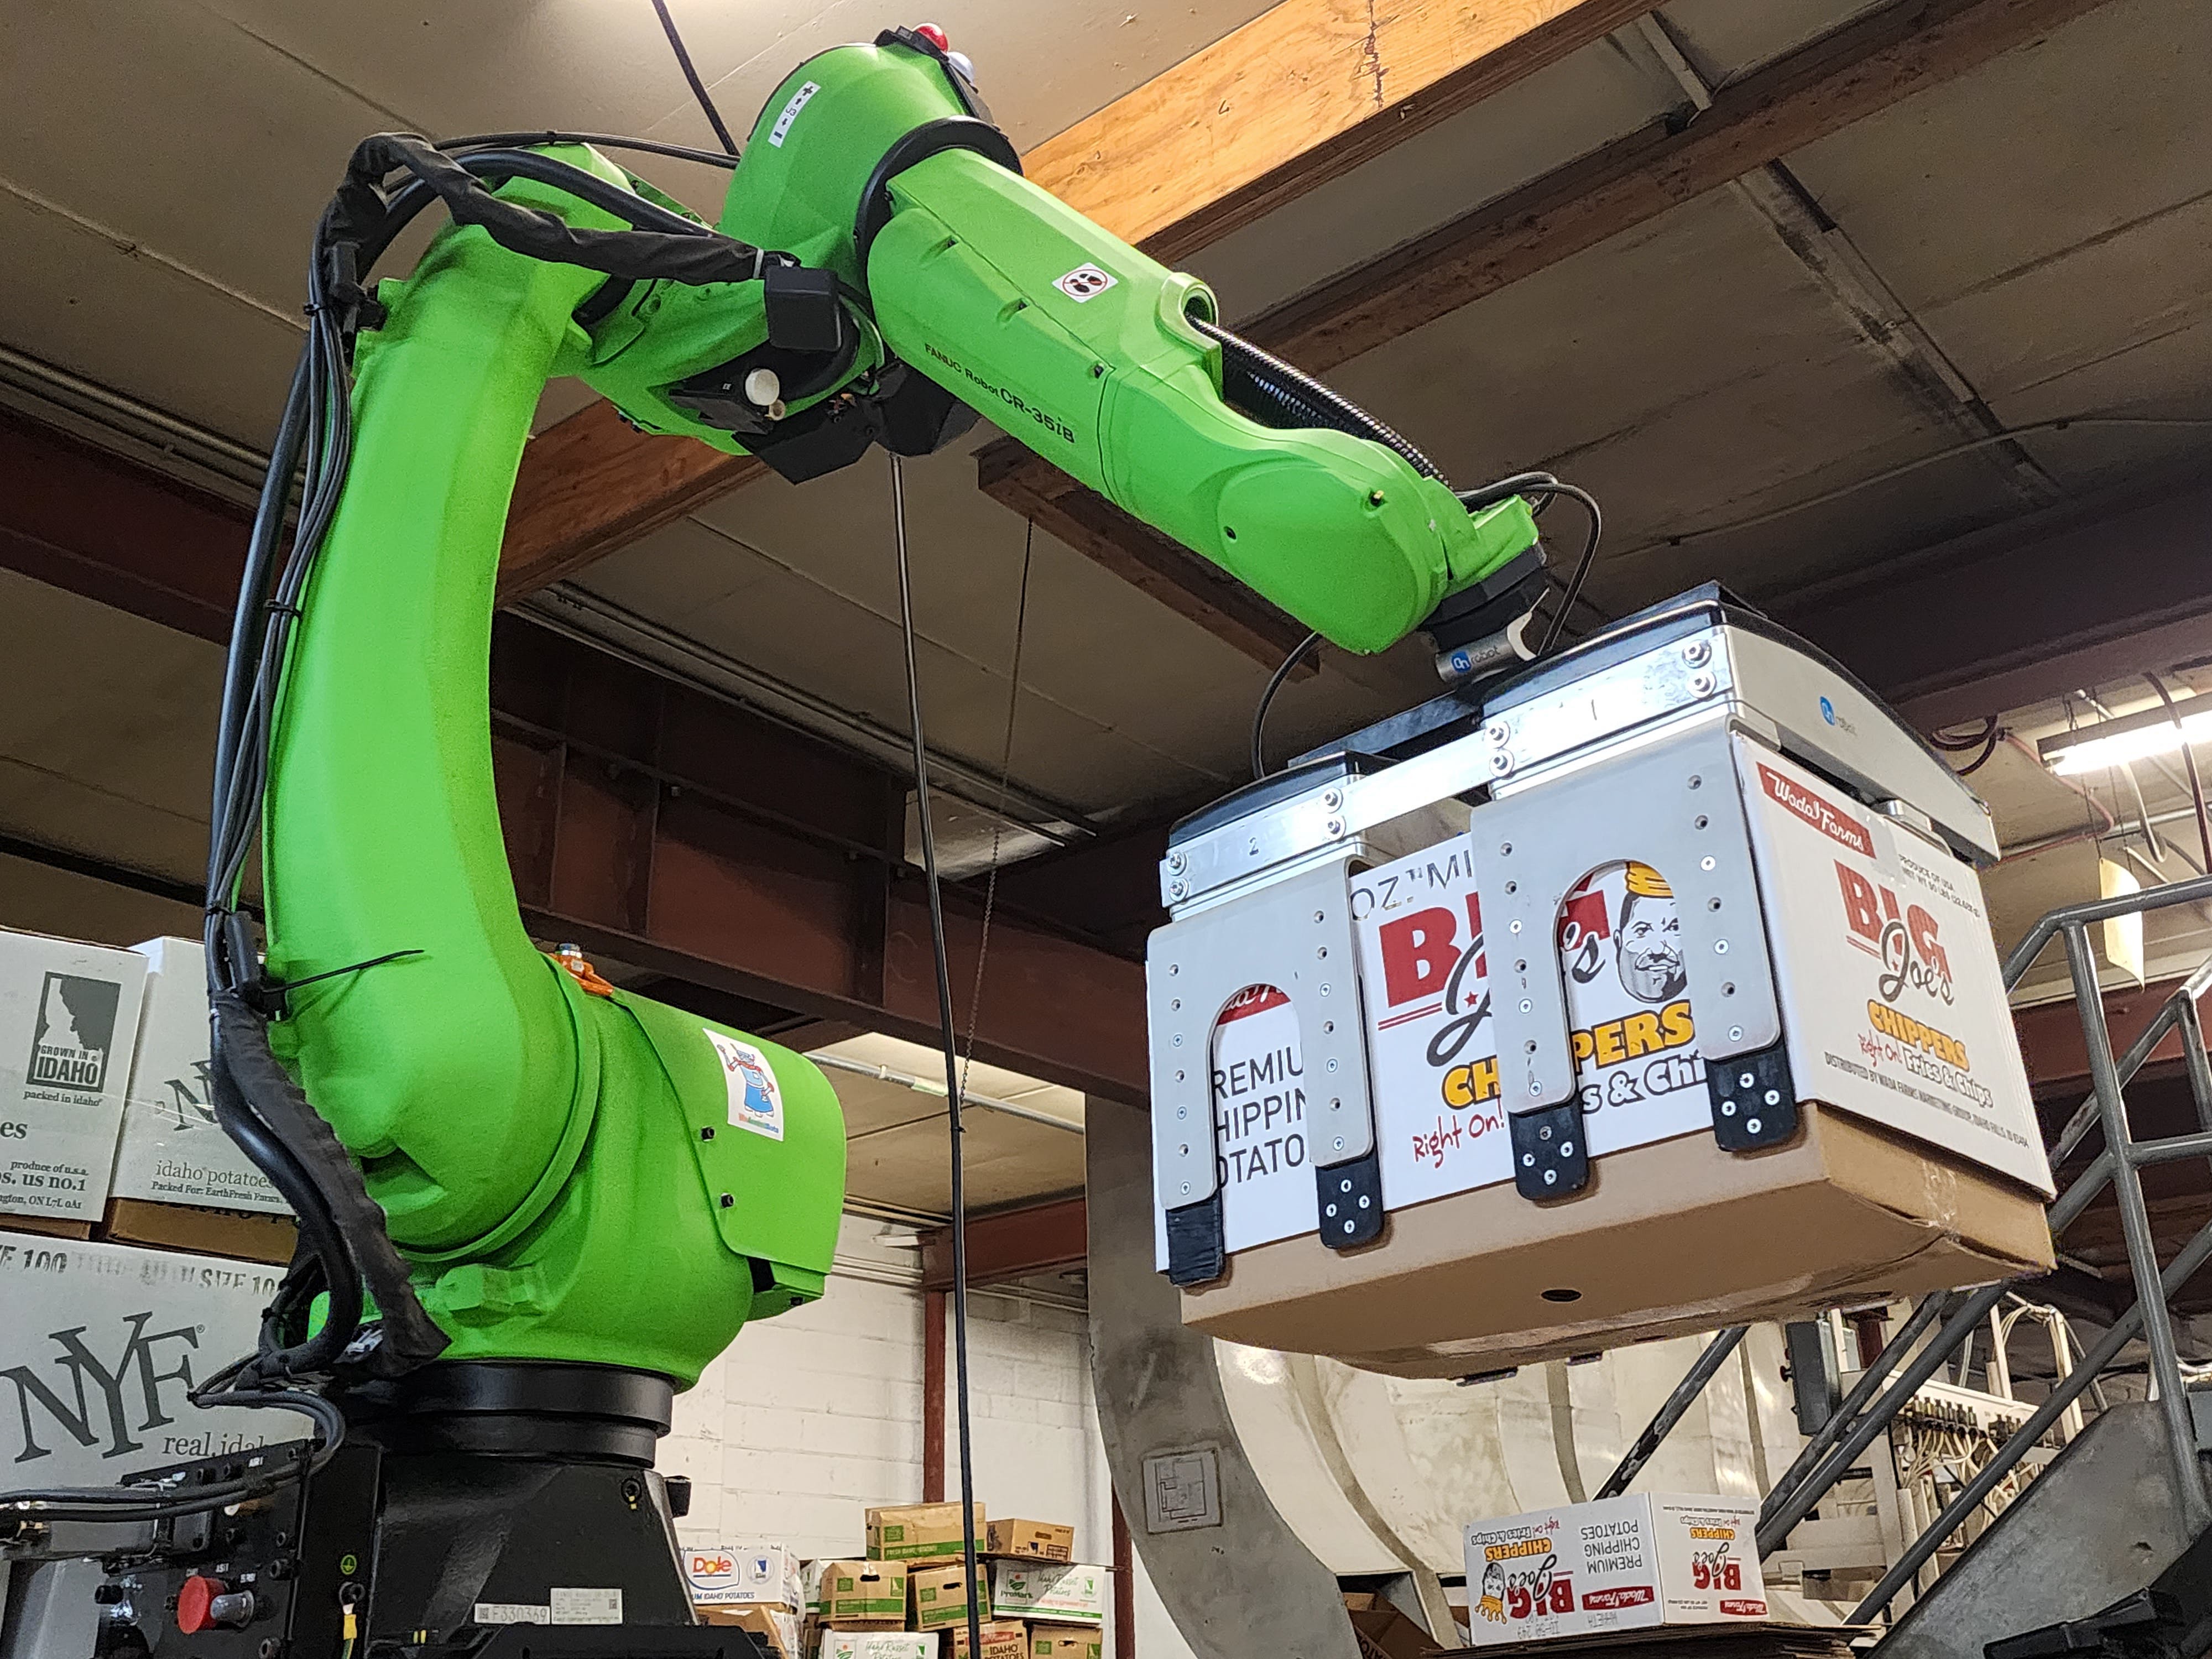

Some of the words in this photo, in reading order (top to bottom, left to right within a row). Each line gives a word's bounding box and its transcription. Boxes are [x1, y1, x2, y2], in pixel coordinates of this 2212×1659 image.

[925, 343, 962, 373] FANUC
[965, 368, 999, 398] Robot
[1000, 388, 1075, 443] CR-35iB
[1766, 772, 1815, 819] Wada
[1820, 808, 1865, 852] Farms
[1249, 837, 1259, 856] 2
[1426, 849, 1473, 889] MI
[1833, 859, 1953, 983] BIG
[1879, 921, 1954, 1006] Joe's
[1867, 999, 1970, 1072] CHIPPERS
[41, 1045, 76, 1058] GROWN
[79, 1051, 89, 1061] IN
[36, 1057, 98, 1085] IDAHO
[1212, 1046, 1303, 1099] REMIU
[1903, 1046, 1942, 1084] Fries
[1942, 1065, 1958, 1092] &
[1955, 1071, 1994, 1108] Chips
[23, 1091, 60, 1102] packed
[61, 1094, 71, 1103] in
[1413, 1116, 1462, 1168] Right
[1468, 1095, 1505, 1138] On!
[1644, 1048, 1708, 1096] Chi
[1217, 1088, 1306, 1142] HIPPIN
[11, 1161, 51, 1172] produce
[53, 1164, 65, 1173] of
[1218, 1134, 1305, 1189] OTATO
[23, 1173, 45, 1187] us
[49, 1176, 86, 1191] no.1
[155, 1160, 204, 1181] idaho
[207, 1170, 275, 1189] potatoes
[29, 1196, 45, 1206] ON
[151, 1180, 183, 1193] Packed
[185, 1184, 204, 1195] For:
[205, 1187, 252, 1201] EarthFresh
[252, 1275, 279, 1297] 10
[0, 1311, 199, 1464] NYF
[1471, 1532, 1498, 1546] Chips
[1507, 1526, 1531, 1539] Fries
[1580, 1519, 1639, 1540] POTATOES
[1690, 1527, 1735, 1540] CHIPPERS
[1485, 1537, 1552, 1562] CHIPPERS
[1584, 1537, 1640, 1557] CHIPPING
[693, 1556, 732, 1574] Dole
[1587, 1554, 1642, 1574] PREMIUM
[1693, 1542, 1730, 1577] Joe's
[1507, 1554, 1557, 1601] Joe's
[1692, 1562, 1741, 1590] BIG
[1000, 1590, 1034, 1599] ProMark
[1507, 1579, 1575, 1619] BIG
[1618, 1589, 1649, 1603] Wada
[492, 1606, 547, 1623] F330369
[990, 1644, 1019, 1655] IDAHO
